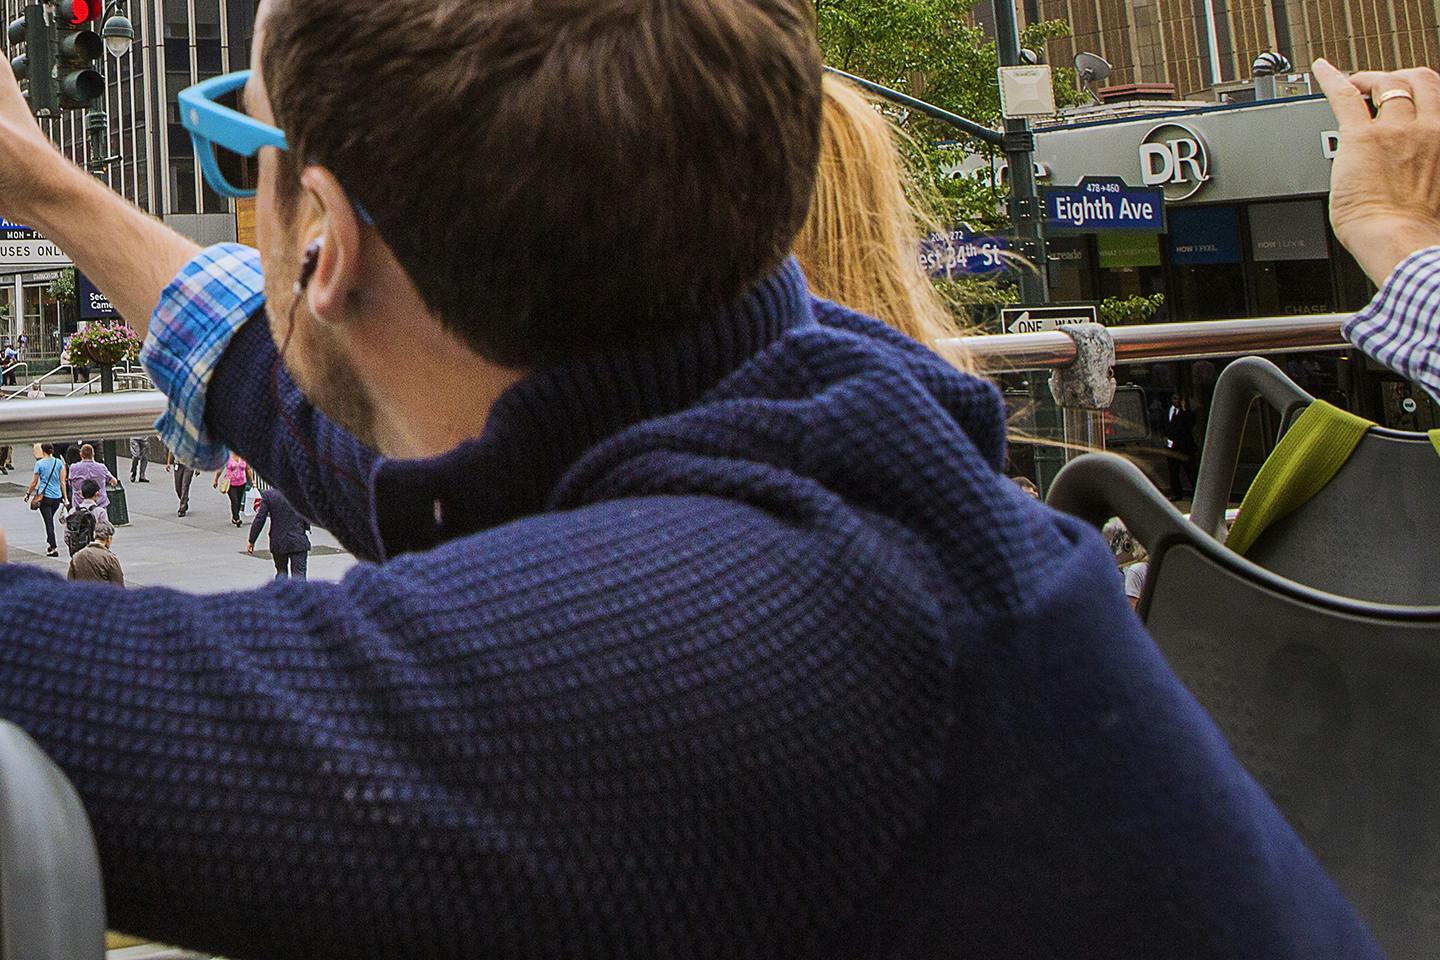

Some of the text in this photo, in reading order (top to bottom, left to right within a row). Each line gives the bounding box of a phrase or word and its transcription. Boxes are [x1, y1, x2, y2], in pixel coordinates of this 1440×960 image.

[1320, 130, 1339, 159] D
[1139, 138, 1209, 186] DR
[1086, 184, 1120, 192] 478 460
[1055, 196, 1153, 226] Eighth Ave
[7, 231, 25, 239] MON
[33, 231, 47, 239] FR
[37, 246, 64, 256] ONL
[918, 249, 943, 270] est
[982, 243, 1001, 266] St
[89, 292, 108, 301] Secu
[91, 301, 113, 310] Came
[1018, 321, 1043, 333] ONE
